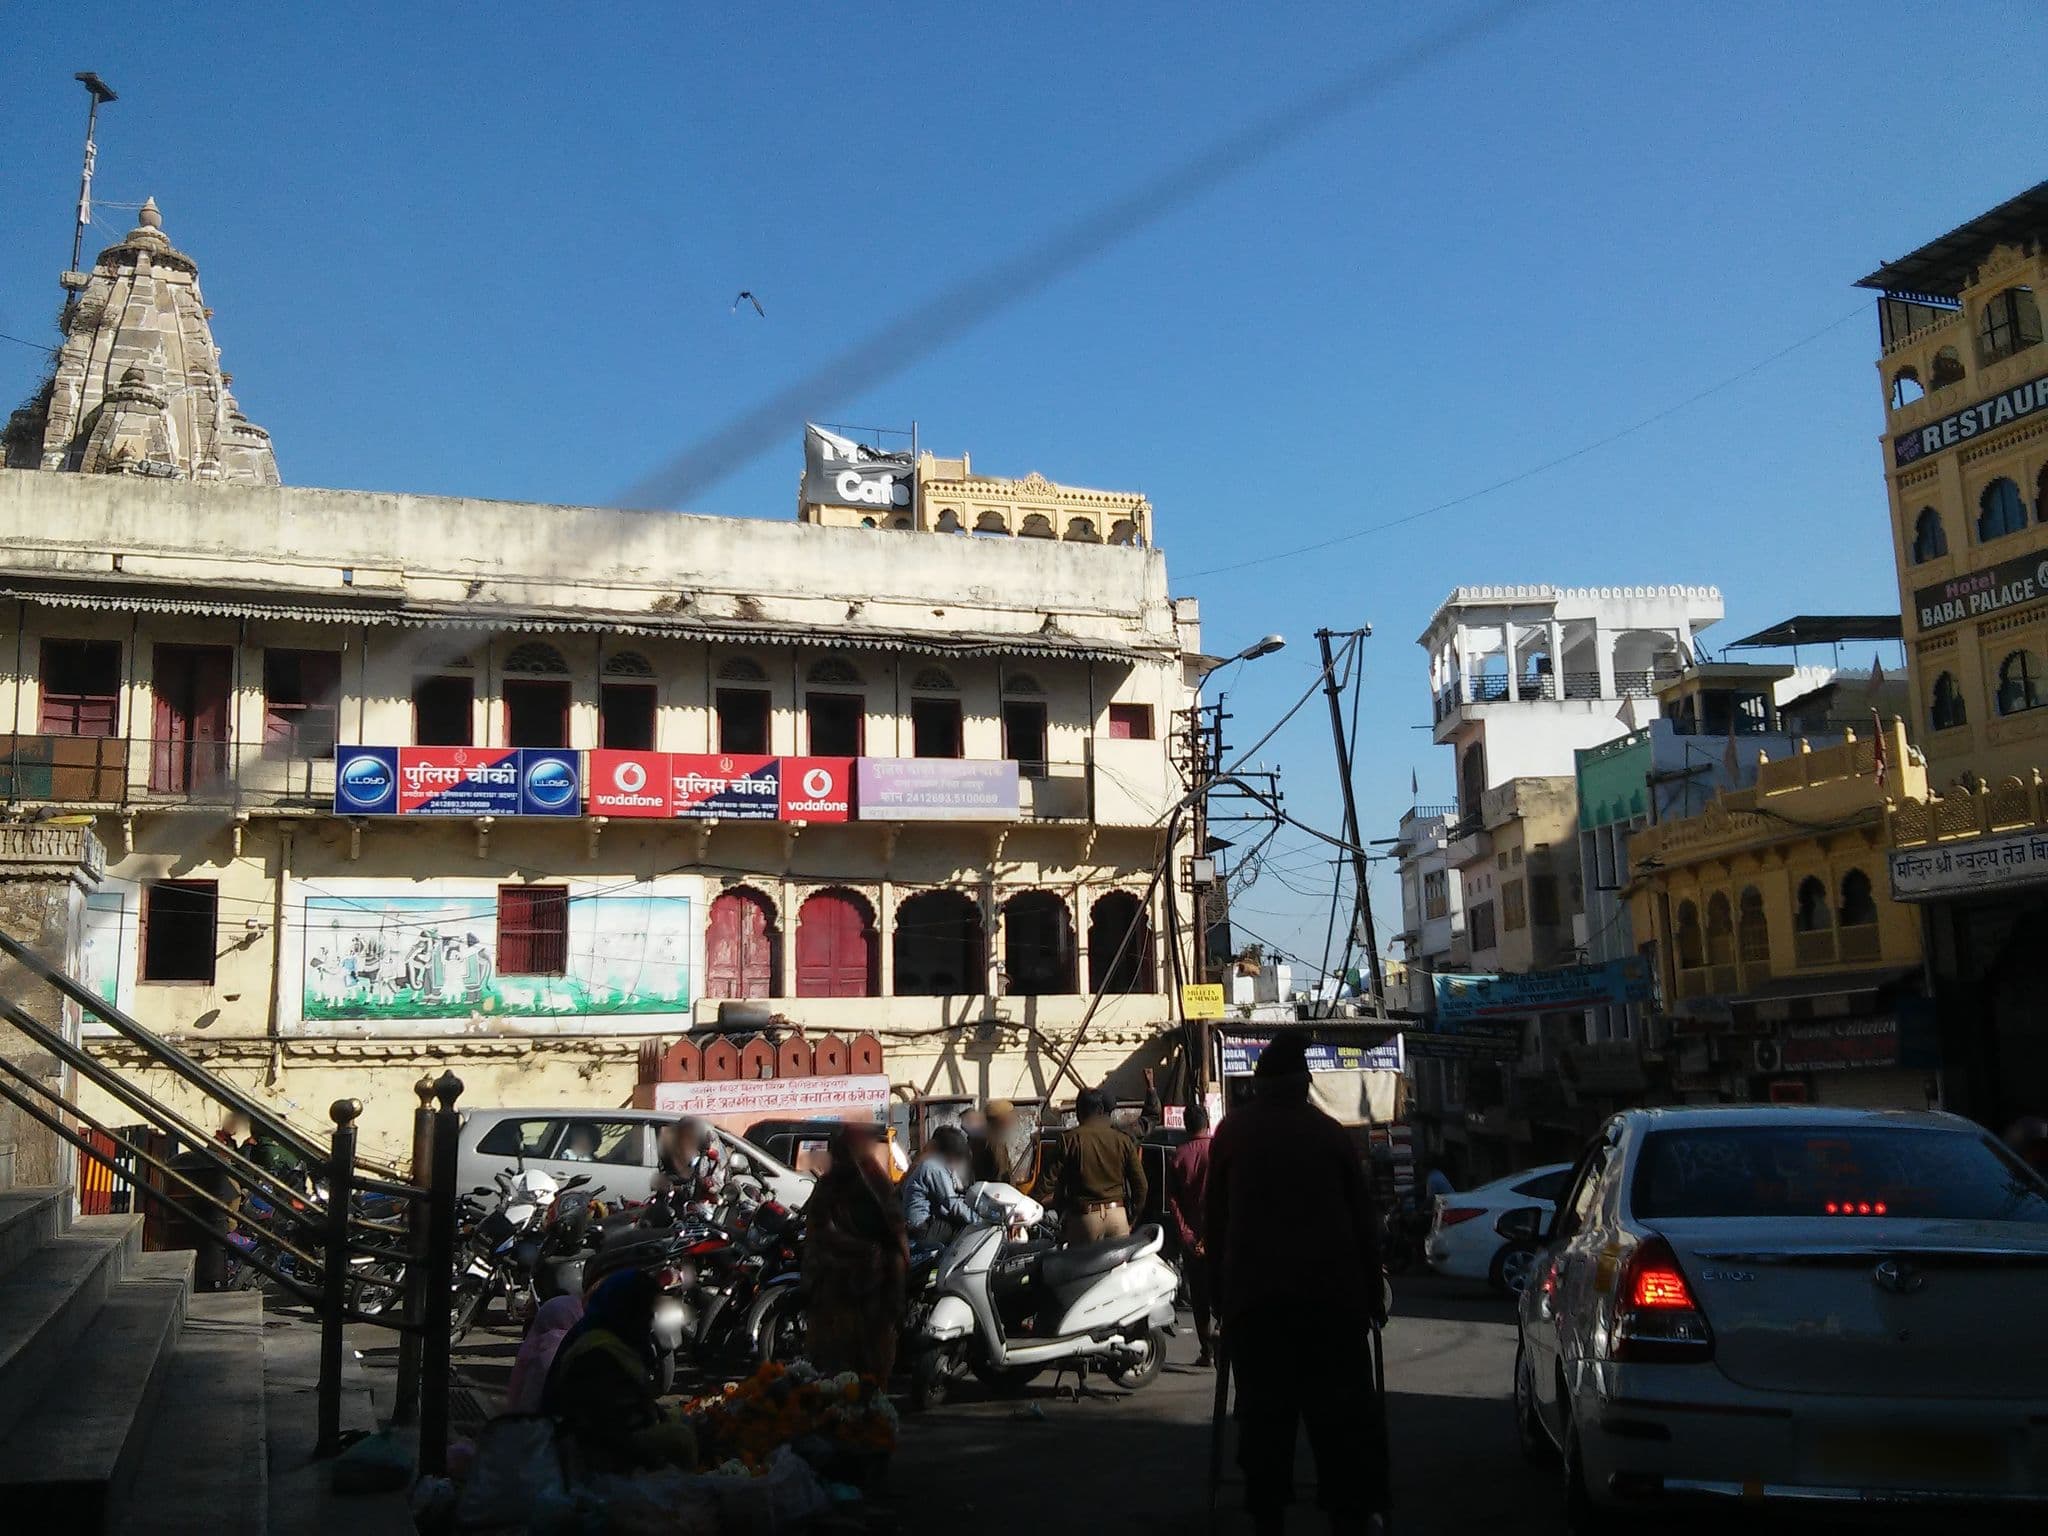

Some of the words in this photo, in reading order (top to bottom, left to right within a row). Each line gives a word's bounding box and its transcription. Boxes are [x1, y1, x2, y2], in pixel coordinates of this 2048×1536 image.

[1921, 599, 1966, 628] BABA
[1969, 577, 2036, 615] PALACE
[347, 776, 386, 786] LLOYD
[403, 761, 461, 790] पुलिस
[465, 761, 518, 785] चौकी
[533, 778, 571, 788] LLOYD
[673, 772, 728, 799] पुलिस
[729, 772, 779, 796] चौकी
[596, 793, 664, 807] vodafone
[787, 799, 848, 812] vodafone
